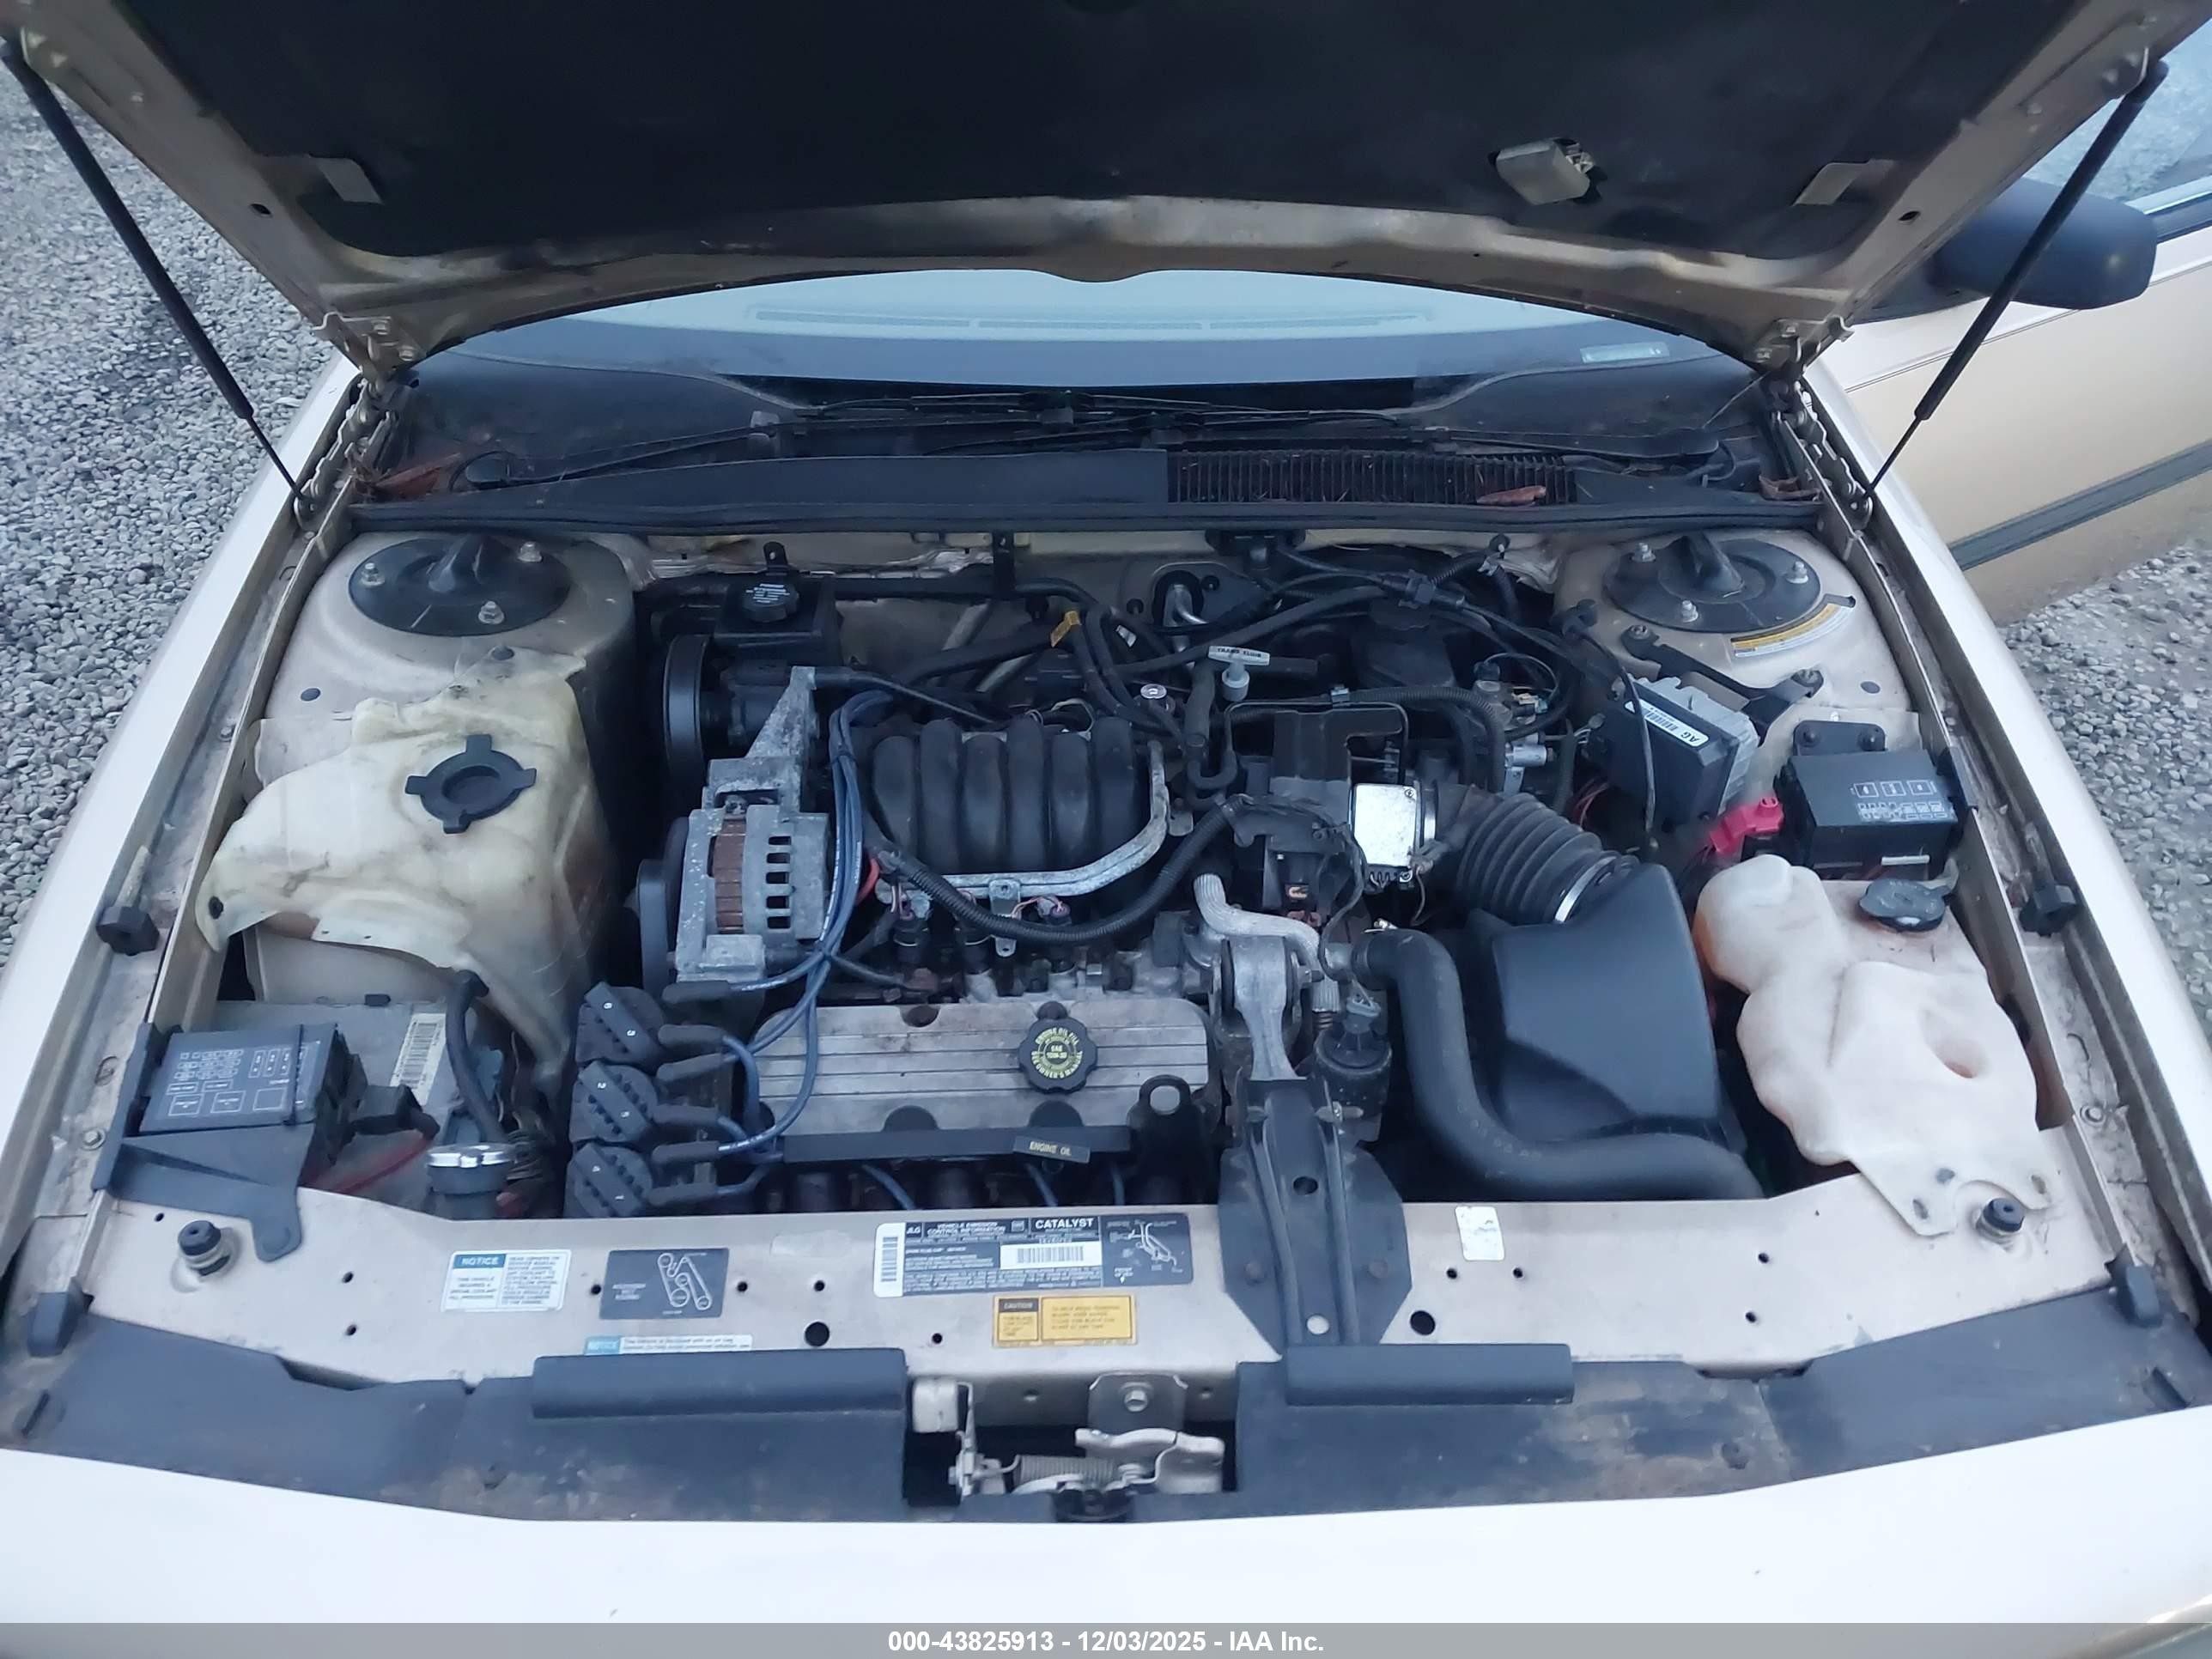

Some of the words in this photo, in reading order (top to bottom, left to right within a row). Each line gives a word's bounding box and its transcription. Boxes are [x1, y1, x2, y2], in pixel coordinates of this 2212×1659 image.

[1030, 1140, 1058, 1154] ENGINE
[1036, 1218, 1094, 1229] CATALYST
[461, 1256, 499, 1266] NOTICE
